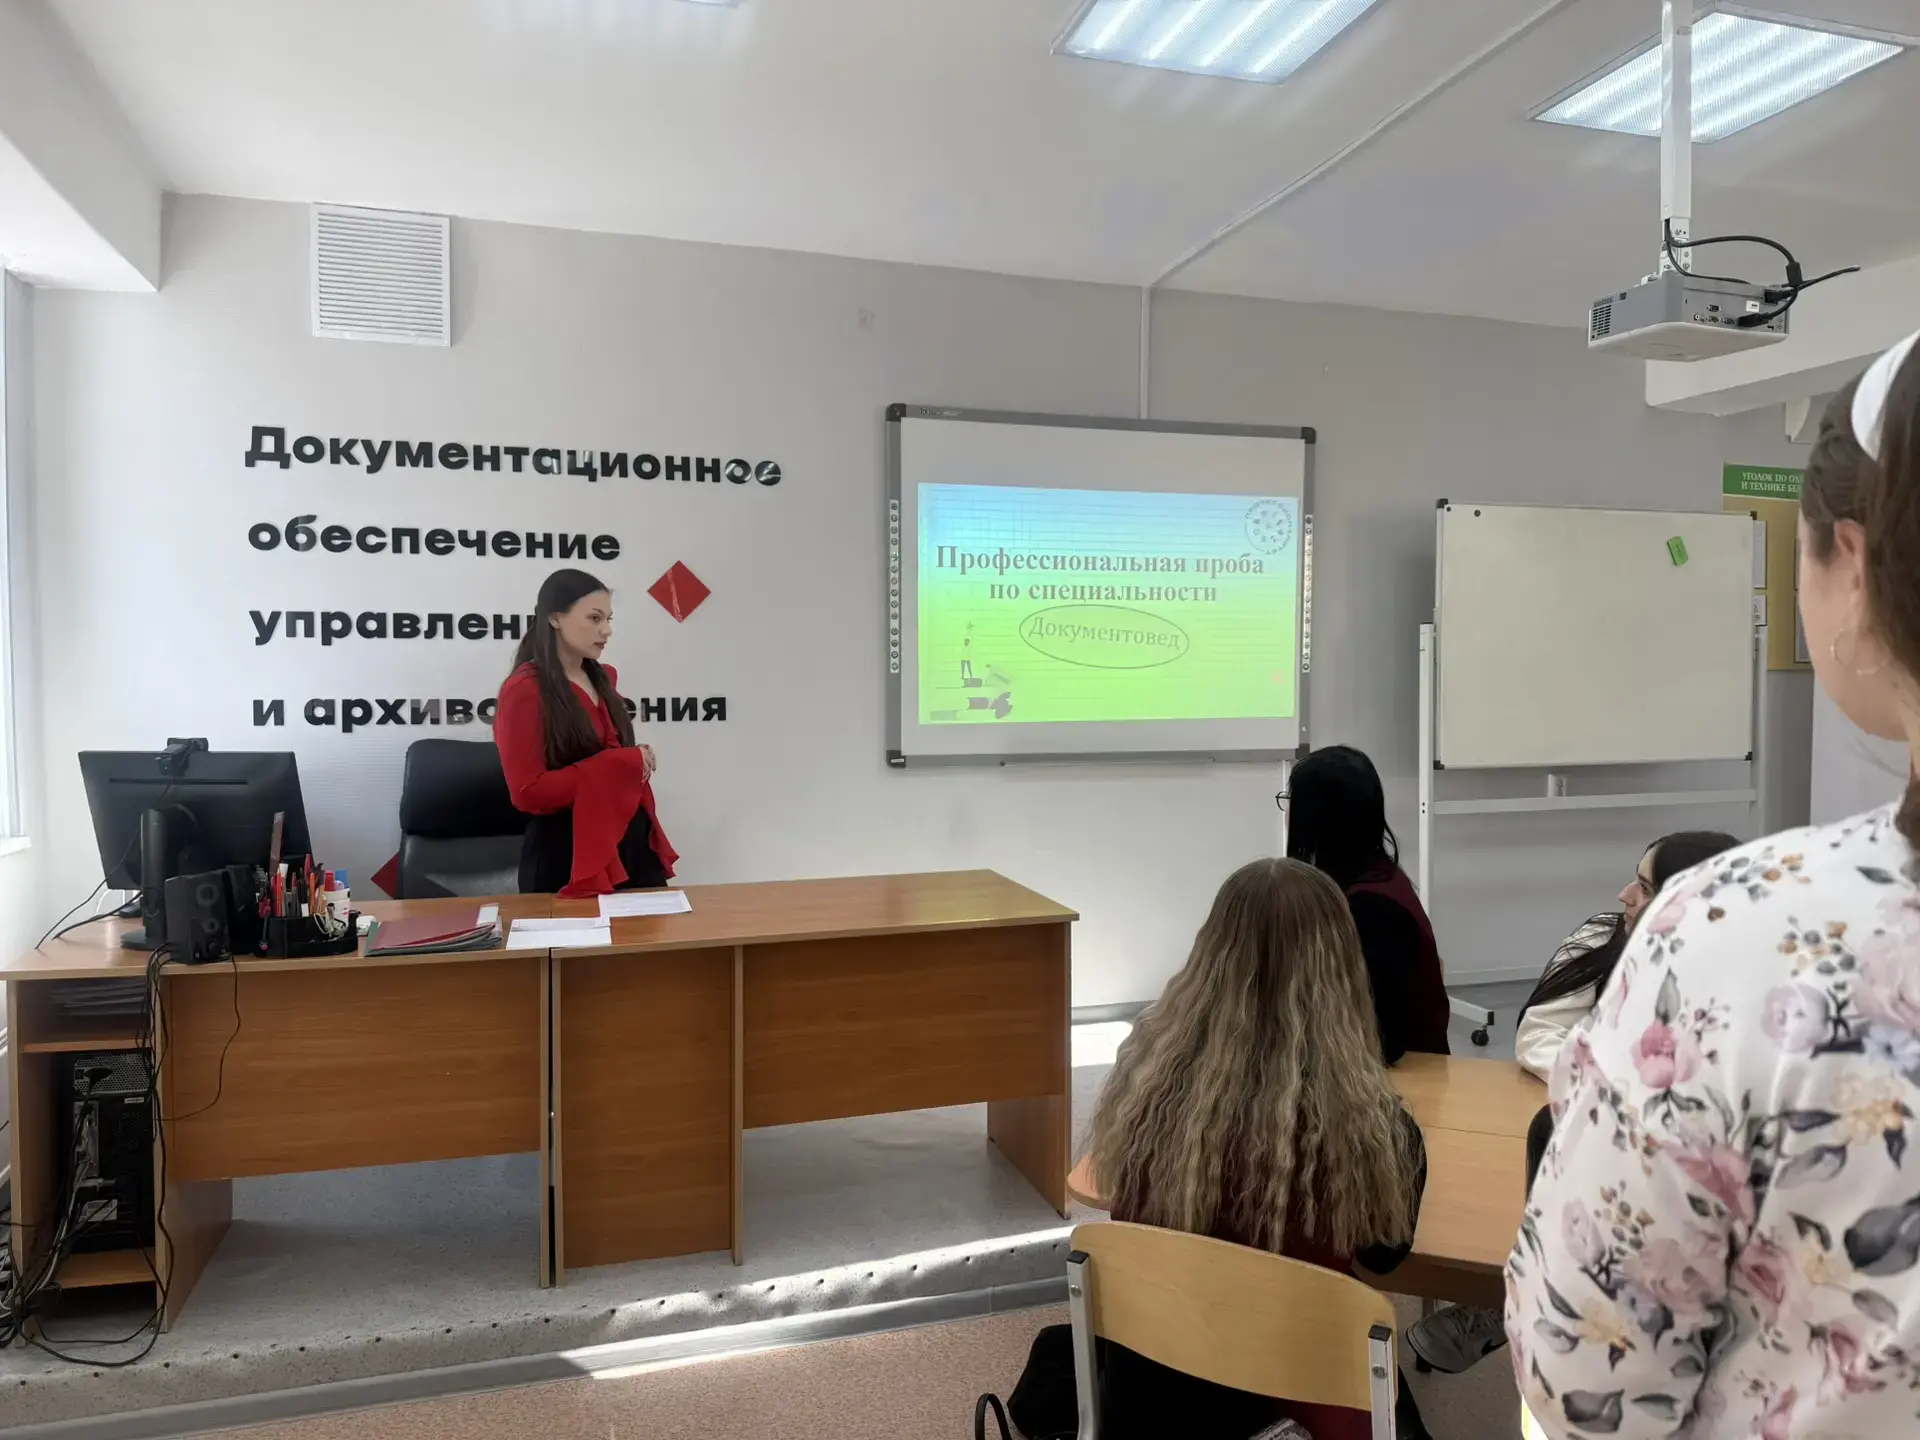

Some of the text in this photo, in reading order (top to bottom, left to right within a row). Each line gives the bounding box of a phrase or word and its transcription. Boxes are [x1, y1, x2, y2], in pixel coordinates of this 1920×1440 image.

[245, 426, 781, 487] Документационное
[1741, 481, 1800, 493] И ТЕХНИКЕ БЕ
[1742, 472, 1773, 481] УГОЛОК
[1775, 474, 1787, 482] ПО
[248, 514, 620, 561] обеспечение
[935, 545, 1264, 578] Профессиональная проба
[989, 583, 1217, 603] по специальности
[249, 611, 537, 646] управлен
[1027, 616, 1180, 649] Документовед
[253, 699, 284, 726] и
